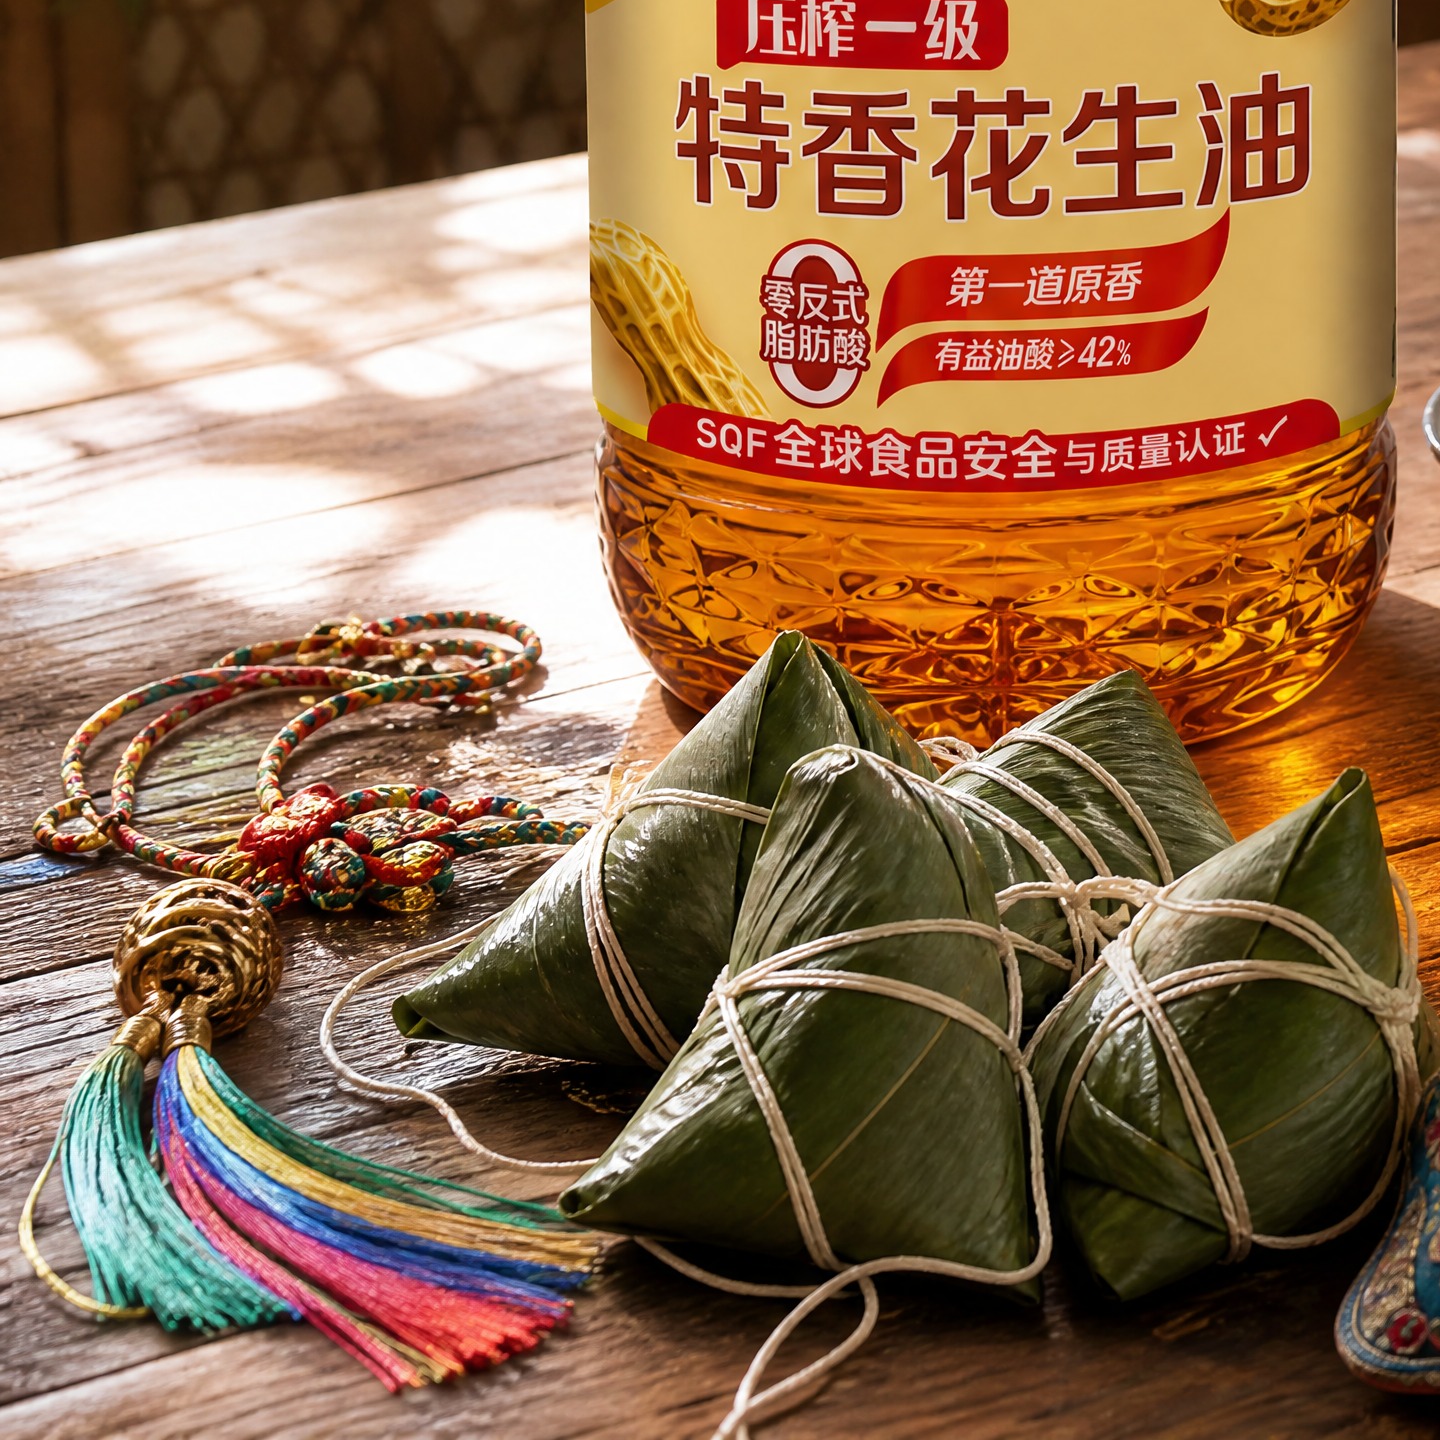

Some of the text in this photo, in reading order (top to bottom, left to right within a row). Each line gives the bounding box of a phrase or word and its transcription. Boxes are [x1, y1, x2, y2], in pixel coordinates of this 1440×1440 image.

[674, 71, 1313, 222] 特香花生油
[945, 261, 1143, 307] 第一道原香
